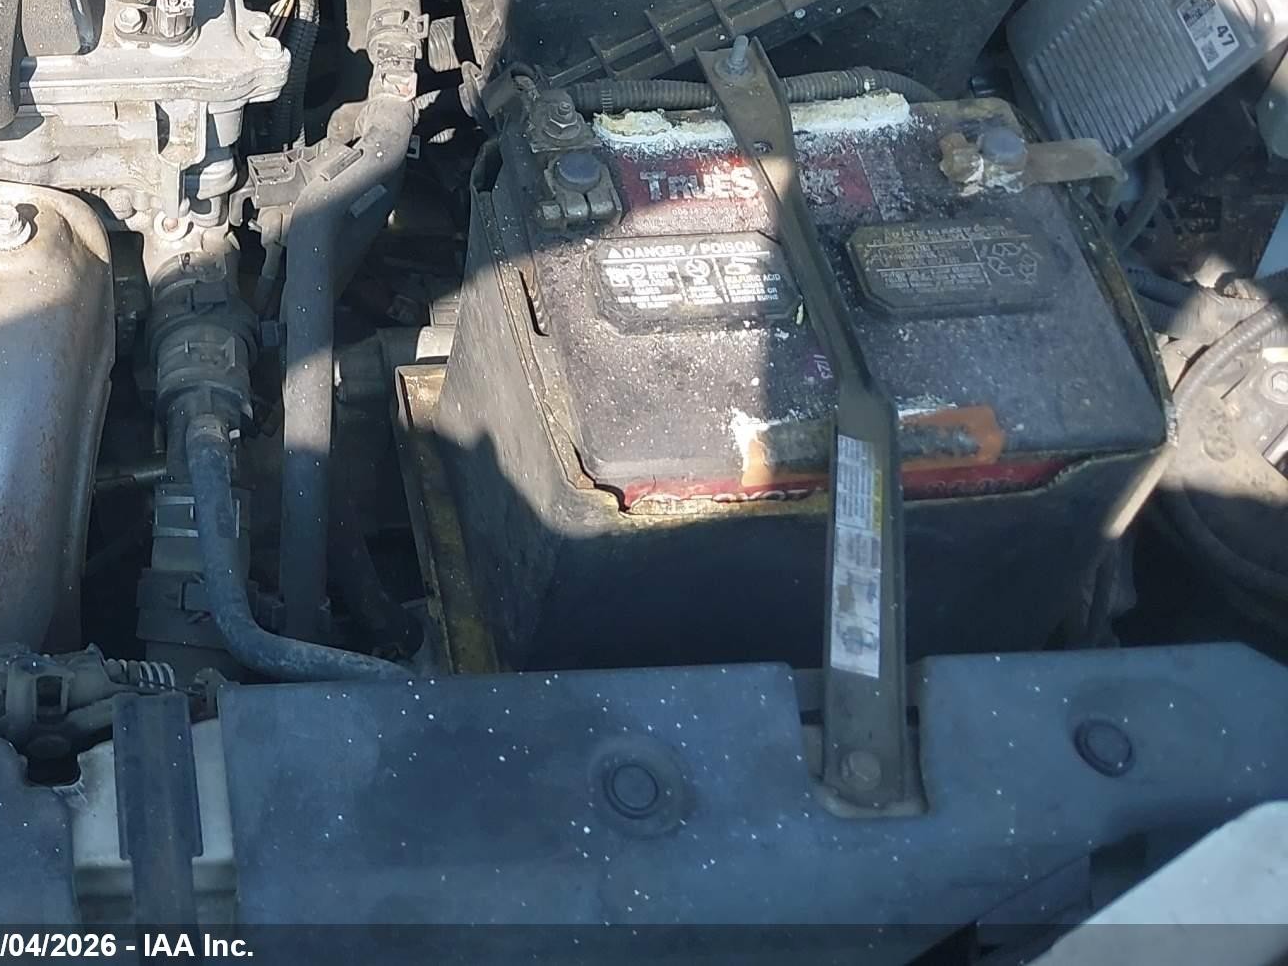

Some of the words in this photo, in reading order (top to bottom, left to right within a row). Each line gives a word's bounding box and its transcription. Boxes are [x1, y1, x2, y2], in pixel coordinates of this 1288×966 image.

[1212, 25, 1236, 48] 47
[625, 245, 686, 258] DANGER
[763, 273, 781, 282] ACID
